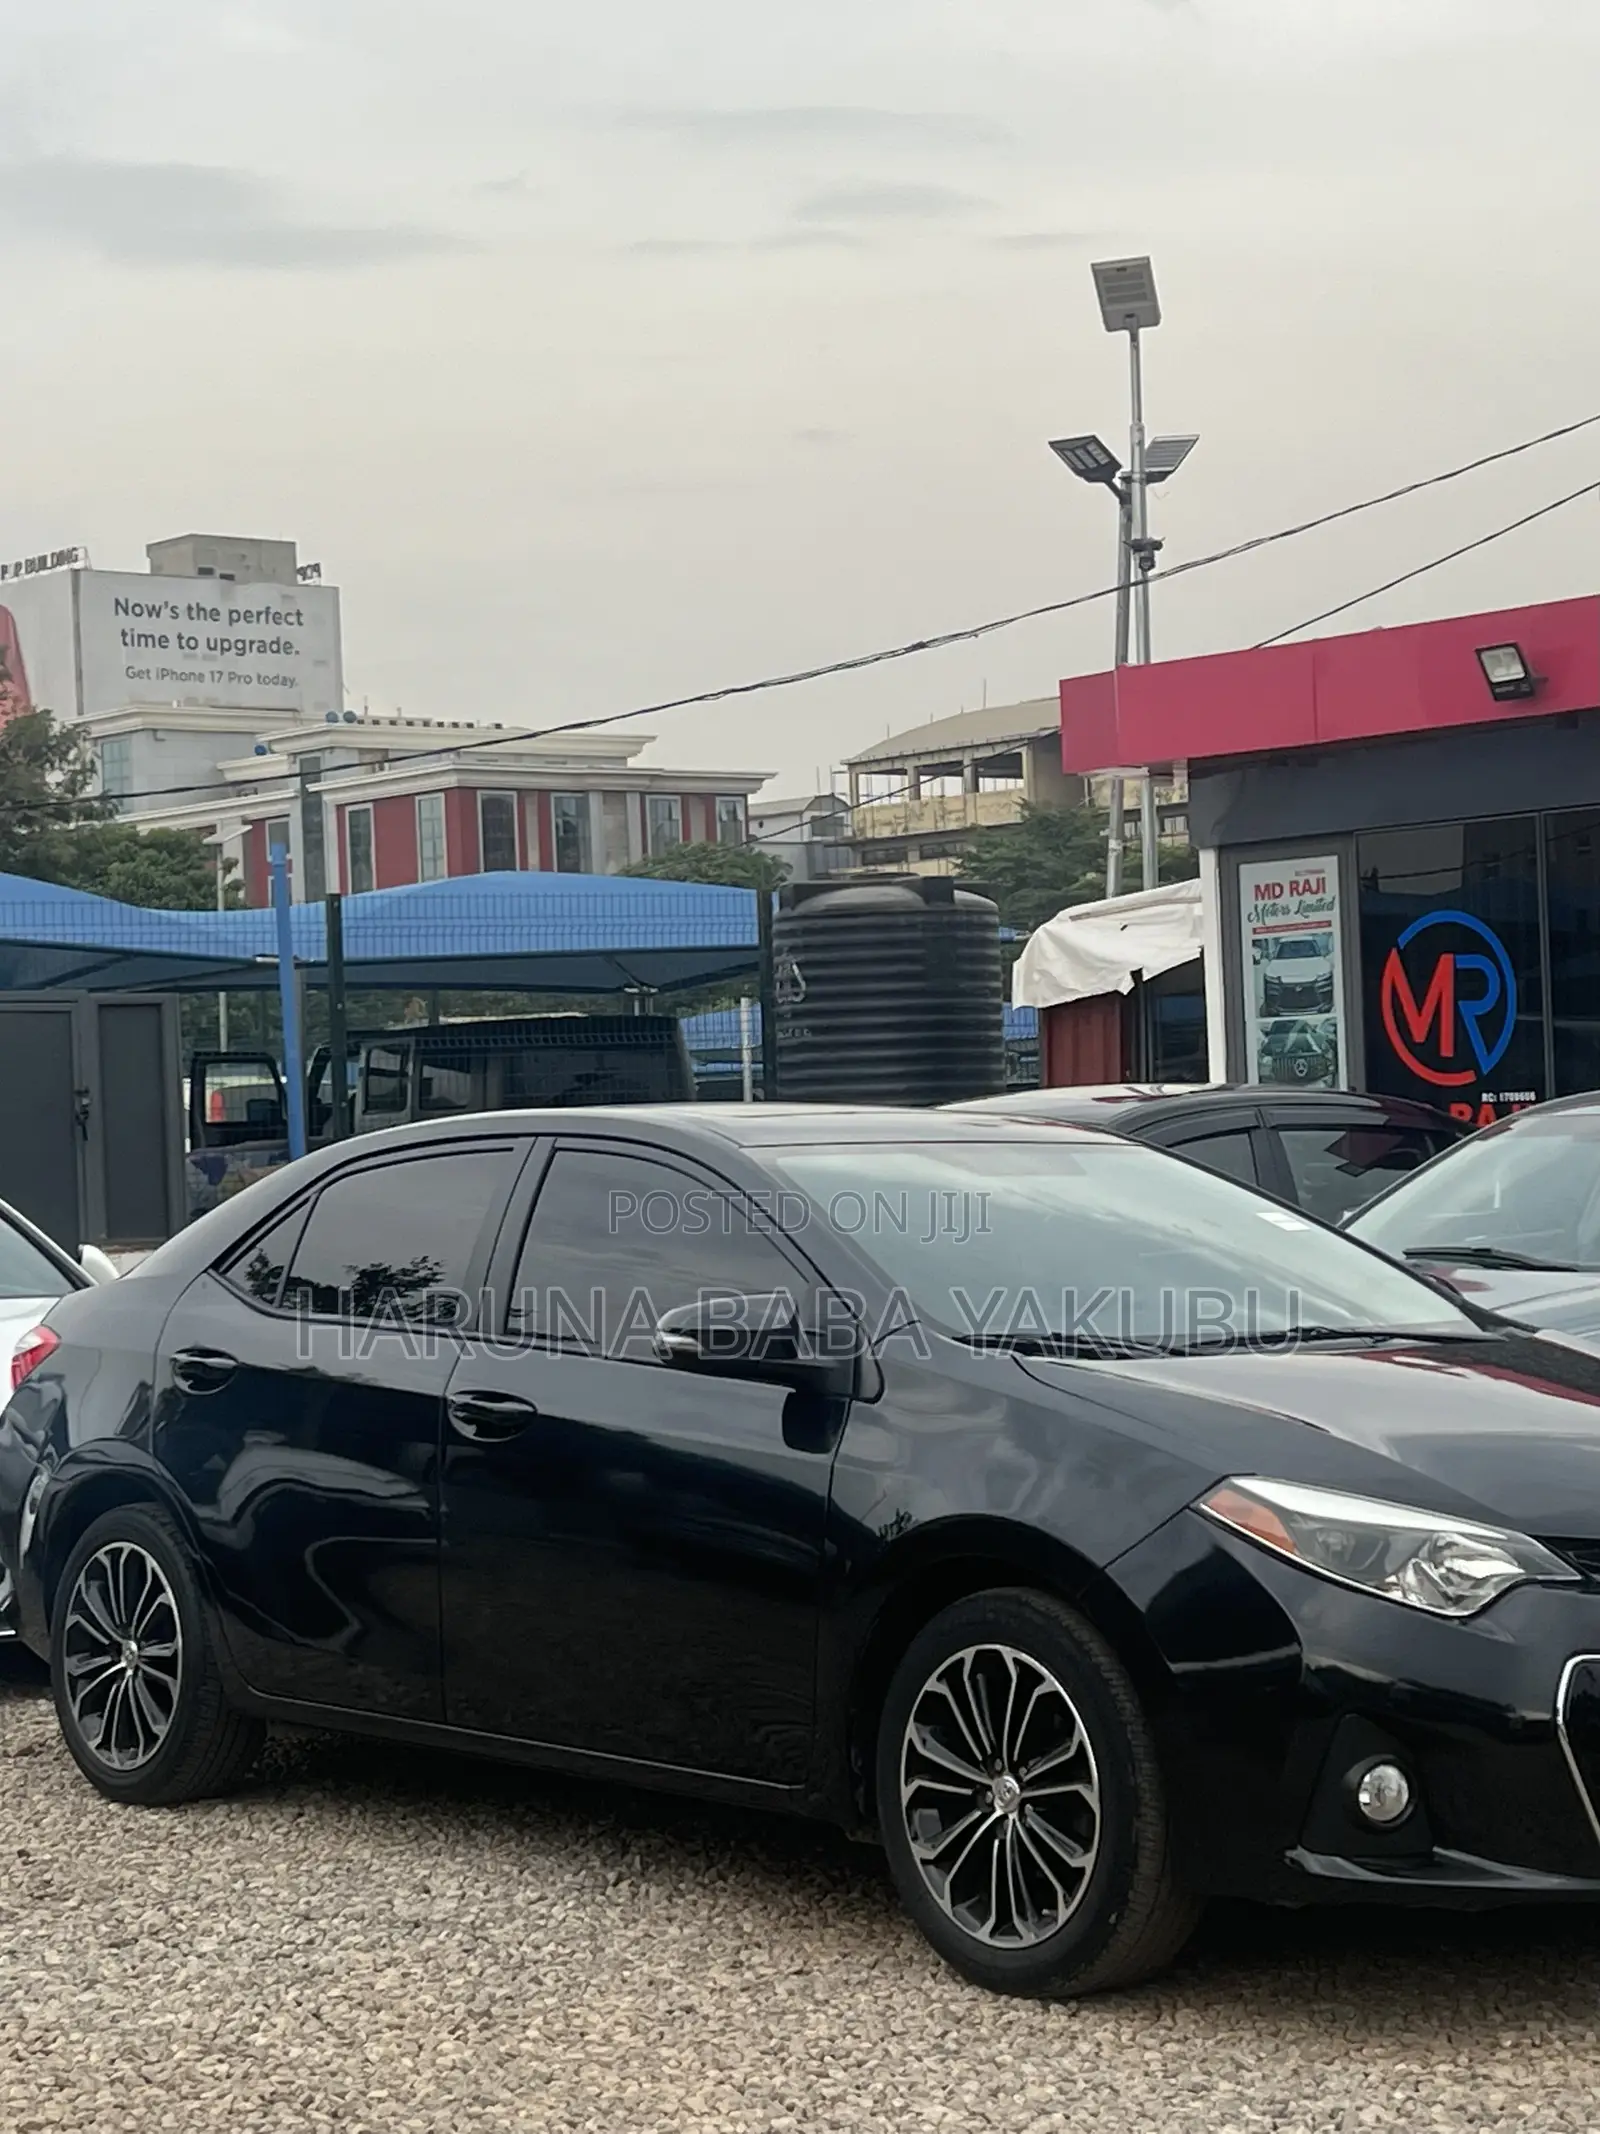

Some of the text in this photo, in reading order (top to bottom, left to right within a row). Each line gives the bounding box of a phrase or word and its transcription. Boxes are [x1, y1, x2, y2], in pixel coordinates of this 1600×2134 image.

[25, 546, 79, 575] BUILDING
[114, 597, 304, 627] Now's the perfect
[120, 628, 300, 657] time to upgrade.
[125, 665, 298, 689] Get iPhone 17 Pro today.
[1254, 877, 1326, 901] MD RAJI
